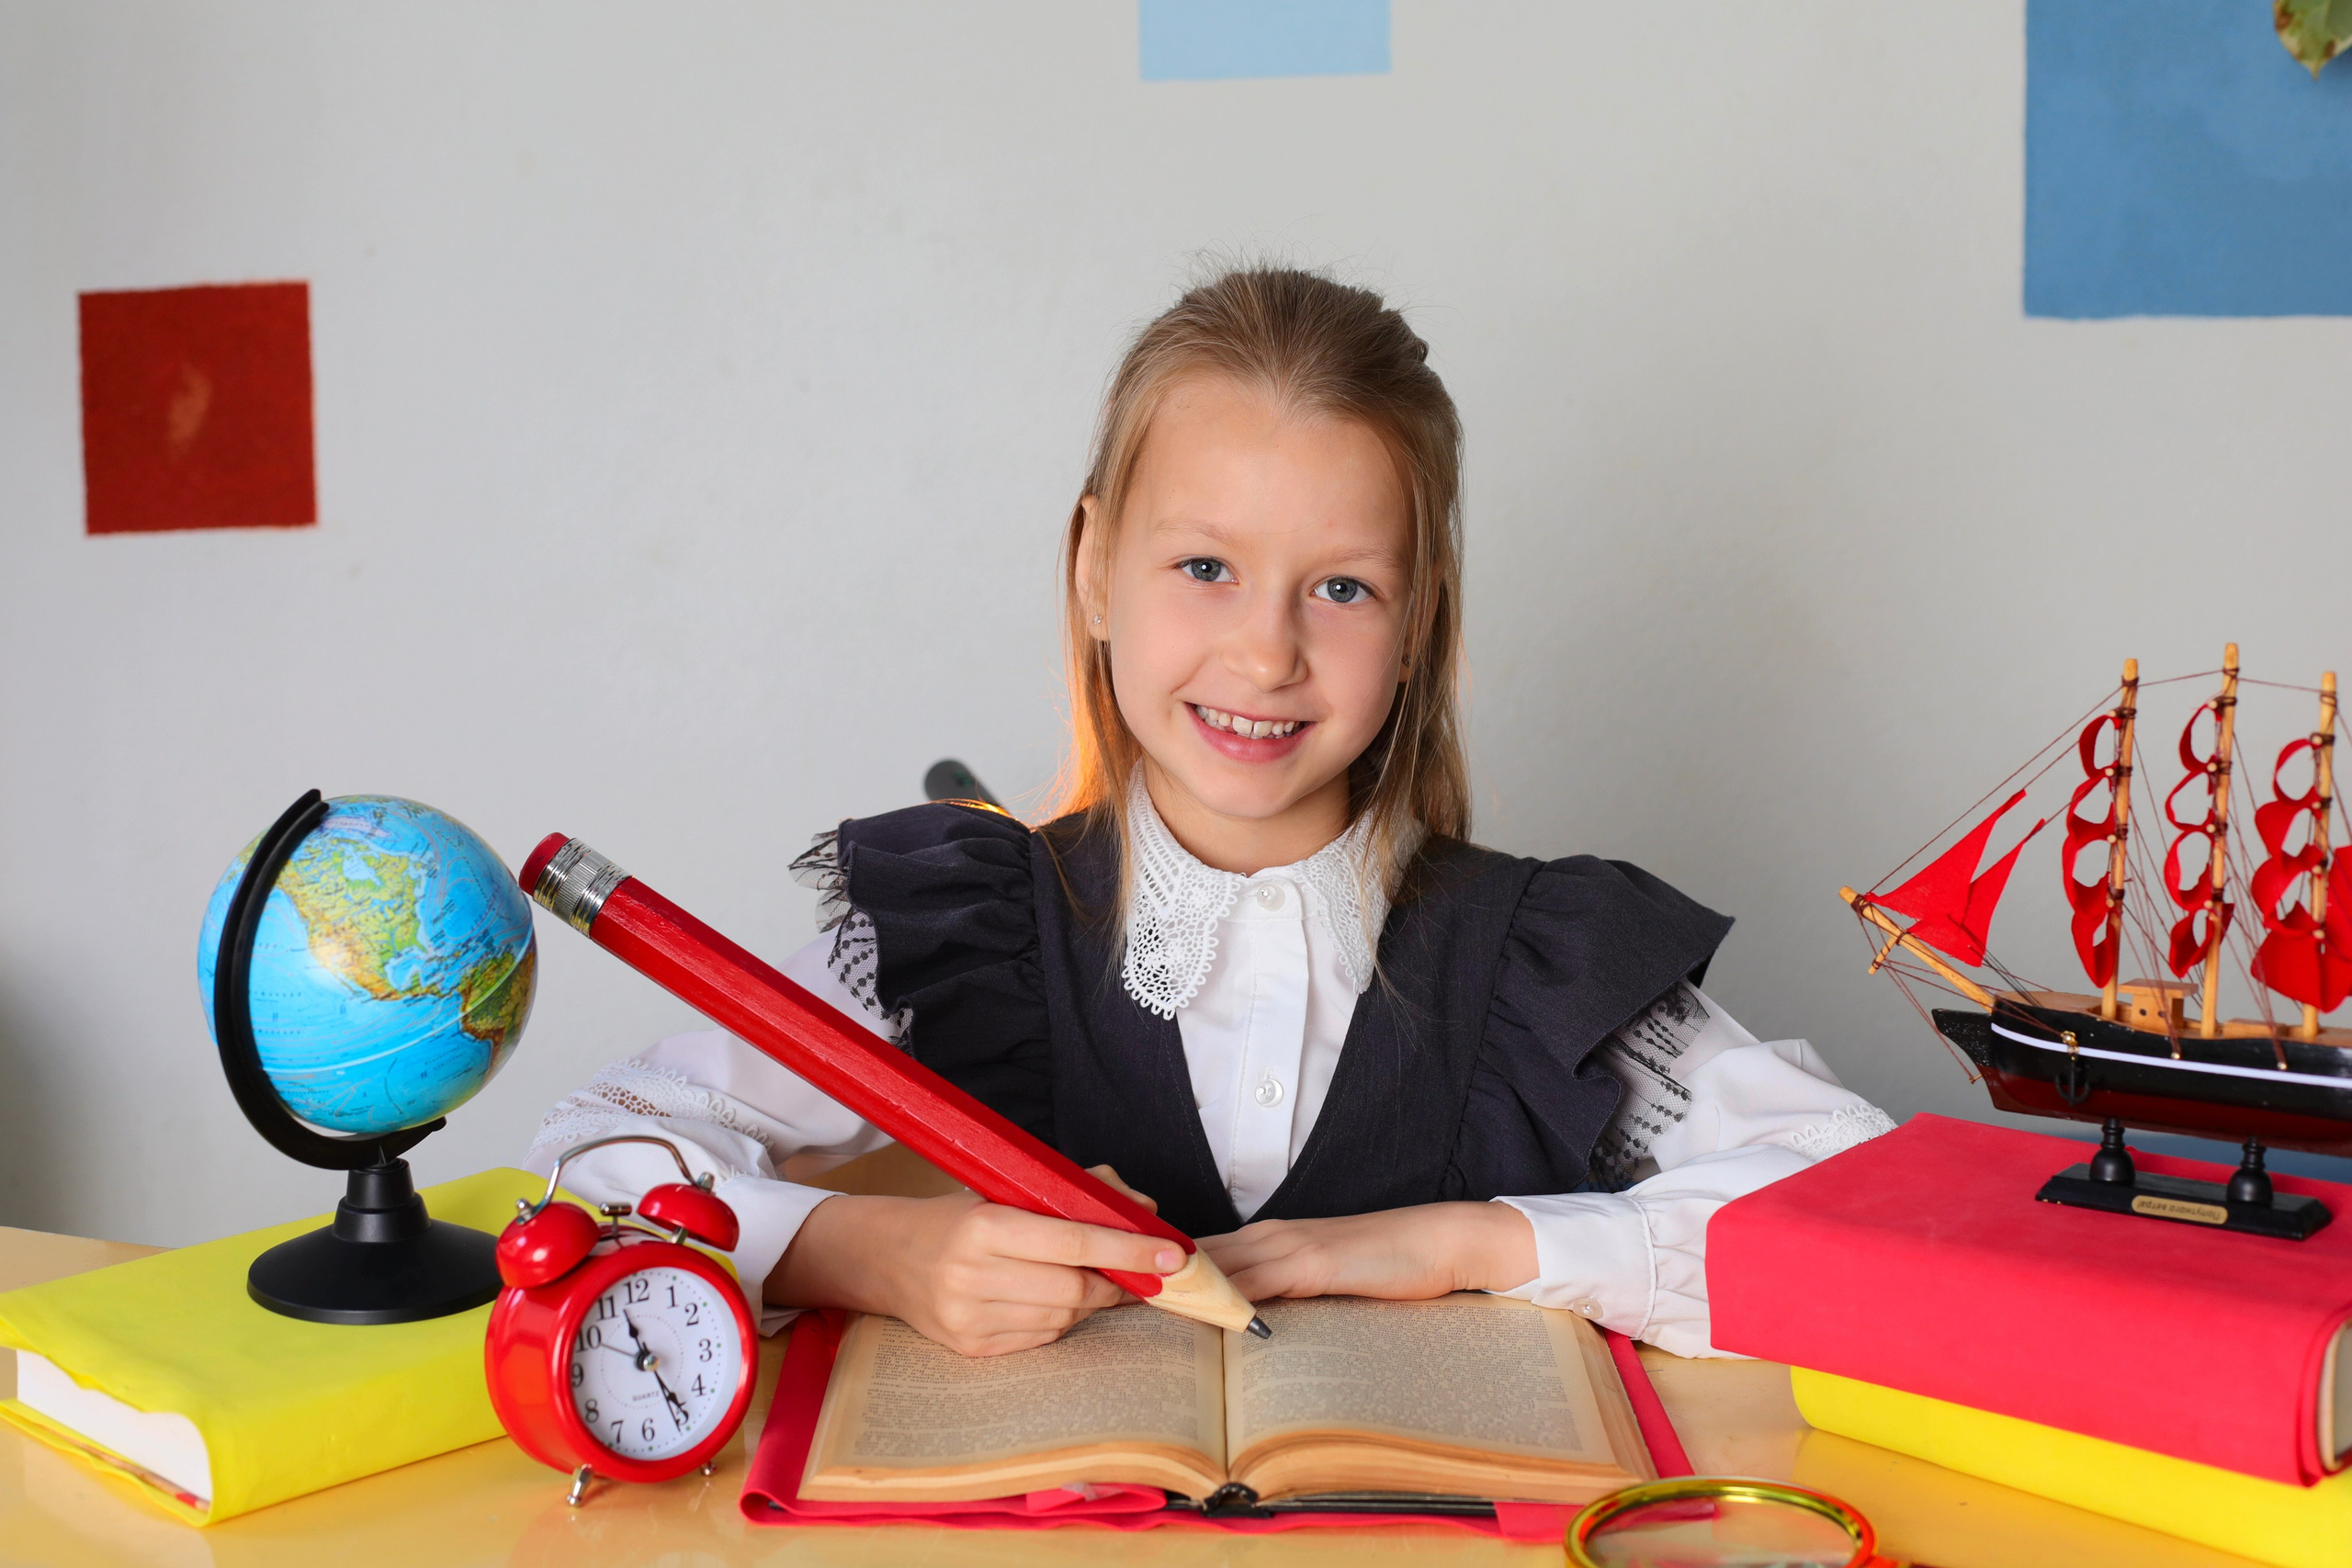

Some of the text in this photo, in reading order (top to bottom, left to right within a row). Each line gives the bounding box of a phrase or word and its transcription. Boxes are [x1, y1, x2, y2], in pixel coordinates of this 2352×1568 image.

[623, 1278, 650, 1305] 12
[665, 1285, 680, 1309] 1
[596, 1295, 619, 1320] 11
[684, 1303, 699, 1326] 2
[575, 1325, 602, 1353] 10
[698, 1338, 712, 1362] 3
[571, 1363, 584, 1388] 9
[691, 1373, 707, 1398] 4
[632, 1390, 660, 1402] QUARTZ
[584, 1399, 599, 1424] 8
[610, 1420, 624, 1443] 7
[641, 1417, 655, 1442] 6
